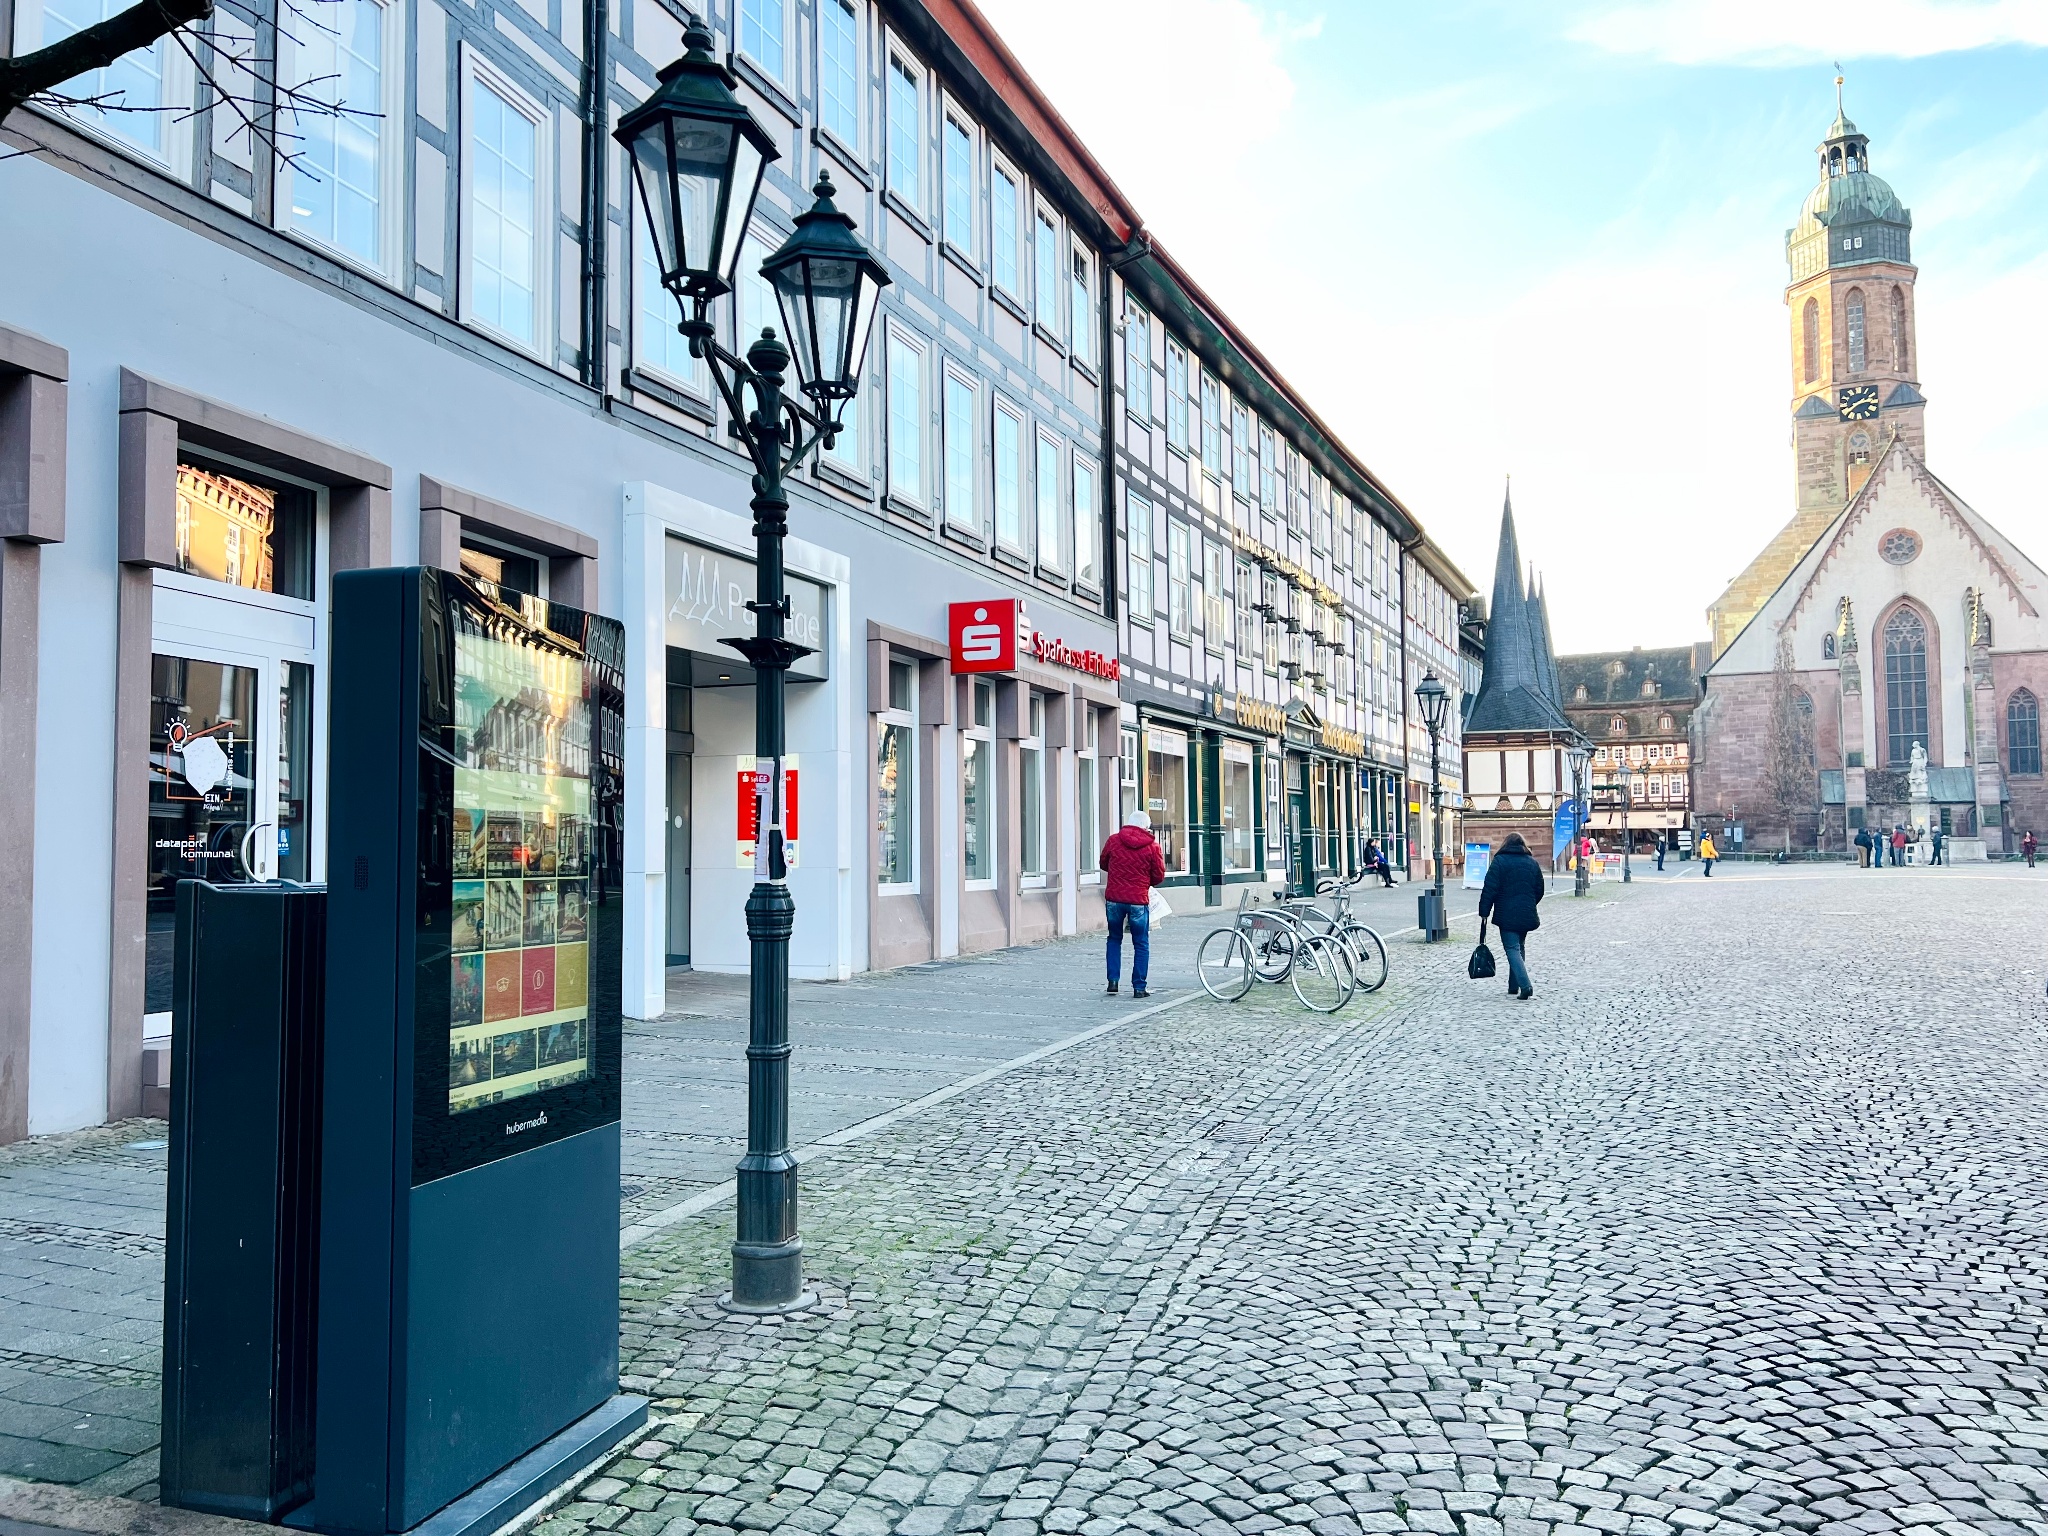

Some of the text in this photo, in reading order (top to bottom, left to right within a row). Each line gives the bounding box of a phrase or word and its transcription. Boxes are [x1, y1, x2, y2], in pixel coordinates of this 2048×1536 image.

[728, 581, 819, 643] Paage
[1034, 631, 1120, 681] Sparkasse Einbeck
[204, 793, 224, 803] EIN.
[155, 838, 204, 850] dataport
[180, 848, 235, 858] kommunal
[506, 1111, 548, 1135] hubermedia
